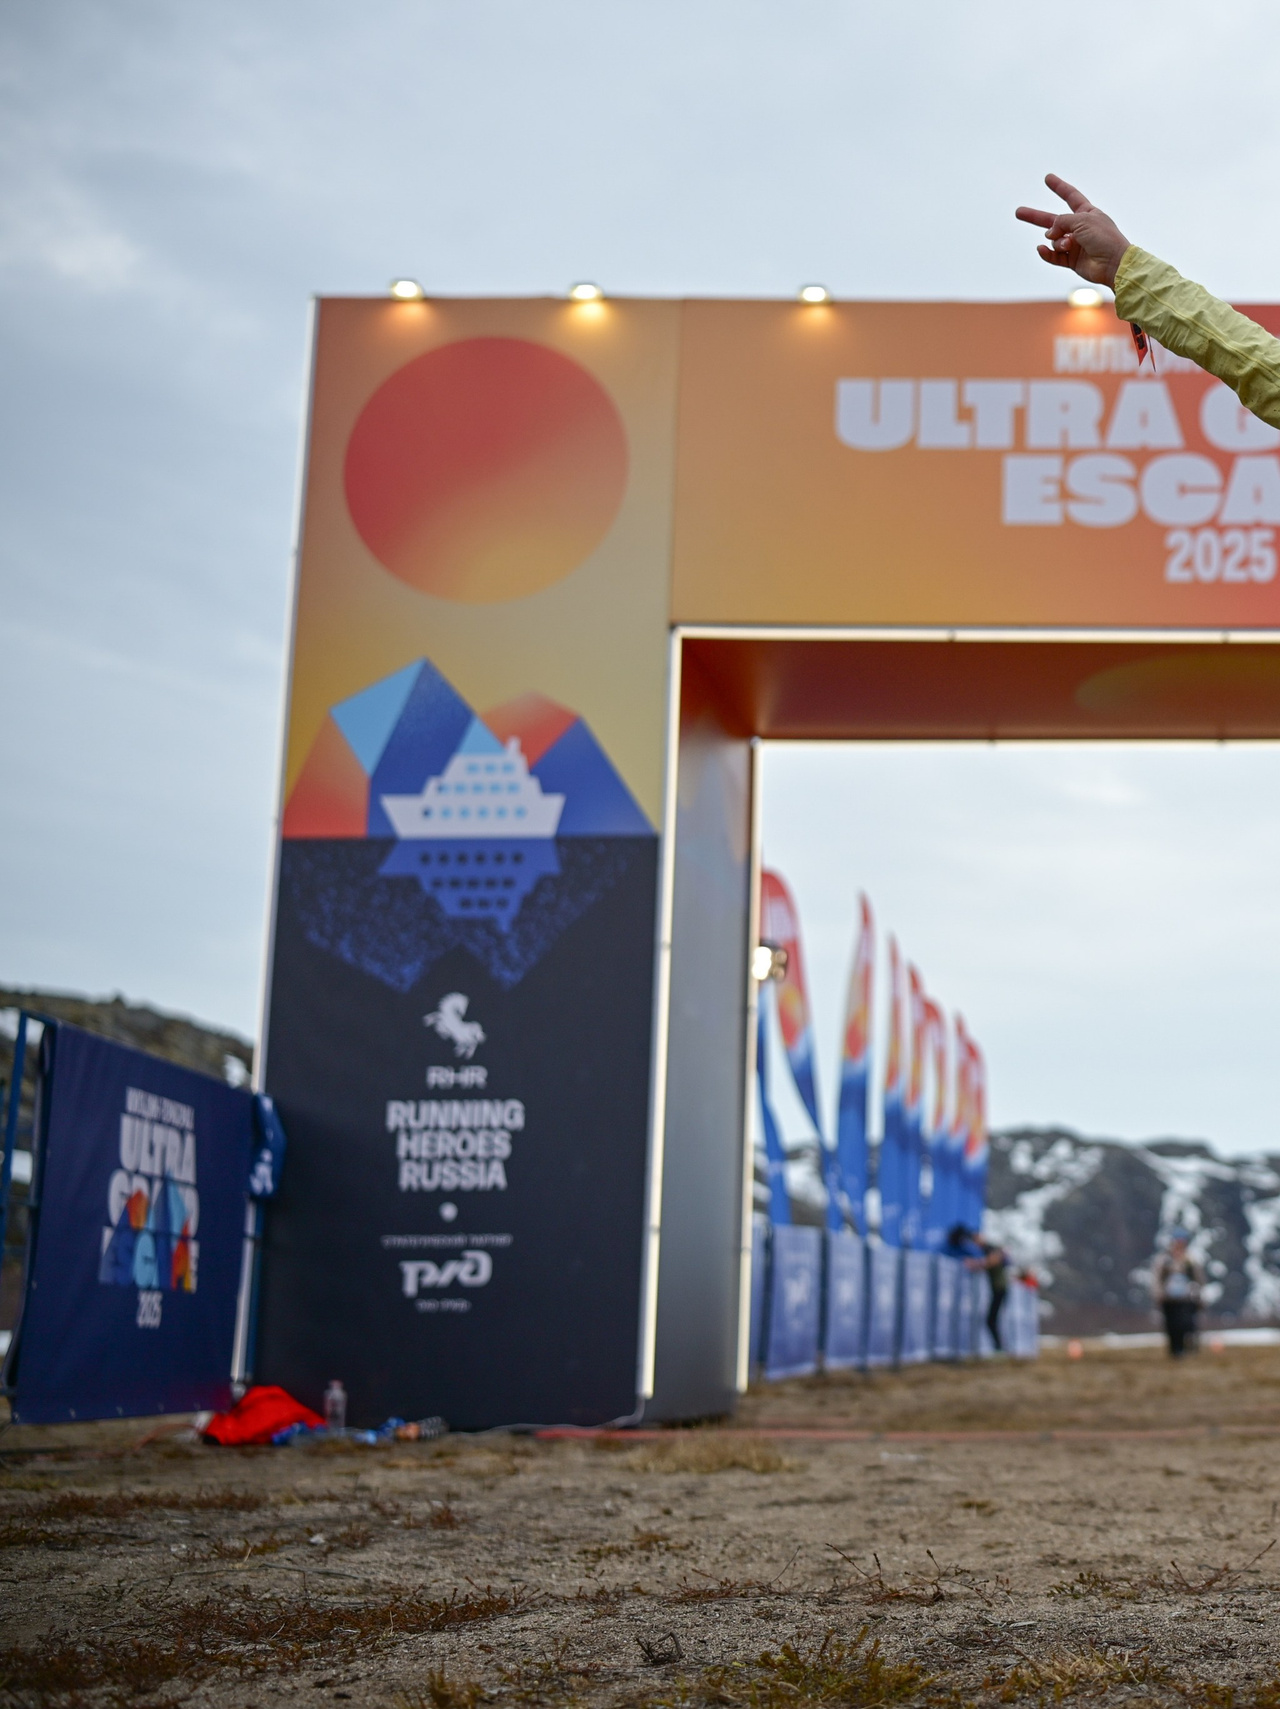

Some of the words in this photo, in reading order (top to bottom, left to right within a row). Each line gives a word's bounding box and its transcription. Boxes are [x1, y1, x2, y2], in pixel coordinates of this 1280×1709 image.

[835, 379, 1185, 451] ULTRA
[1165, 530, 1276, 582] 2025
[386, 1098, 526, 1132] RUNNING
[119, 1112, 197, 1185] ULTRA
[396, 1131, 512, 1160] HEROES
[399, 1159, 508, 1192] RUSSIA
